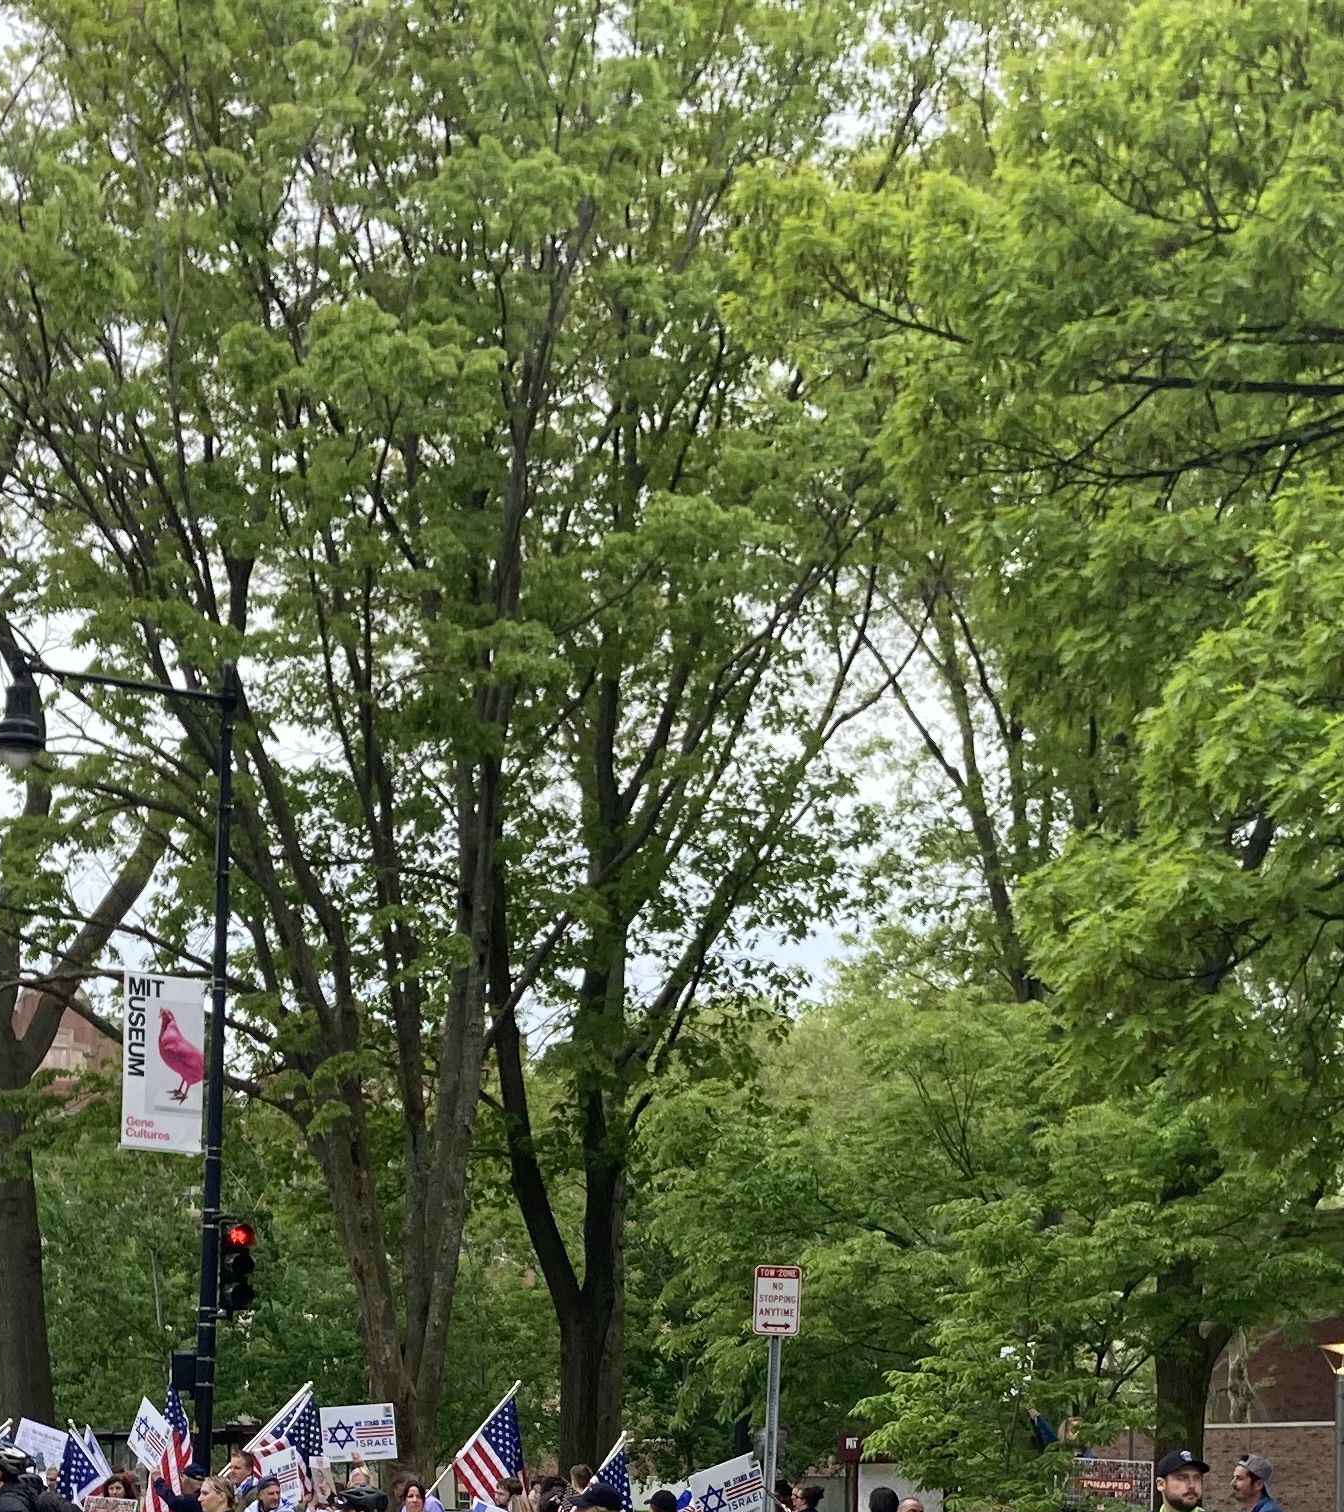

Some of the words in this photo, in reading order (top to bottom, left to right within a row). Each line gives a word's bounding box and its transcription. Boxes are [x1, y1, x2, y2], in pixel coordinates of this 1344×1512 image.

[128, 976, 164, 998] MIT
[126, 1115, 154, 1127] Gene
[125, 1127, 170, 1141] Cultures
[760, 1268, 776, 1276] TOW
[777, 1268, 797, 1278] ZONE
[772, 1281, 784, 1291] NO
[758, 1294, 797, 1304] STOPPING
[758, 1307, 795, 1317] ANYTIME
[356, 1438, 395, 1448] ISRAEL
[723, 1479, 731, 1488] WE
[733, 1473, 748, 1485] STAND
[728, 1490, 764, 1512] ISRAEL
